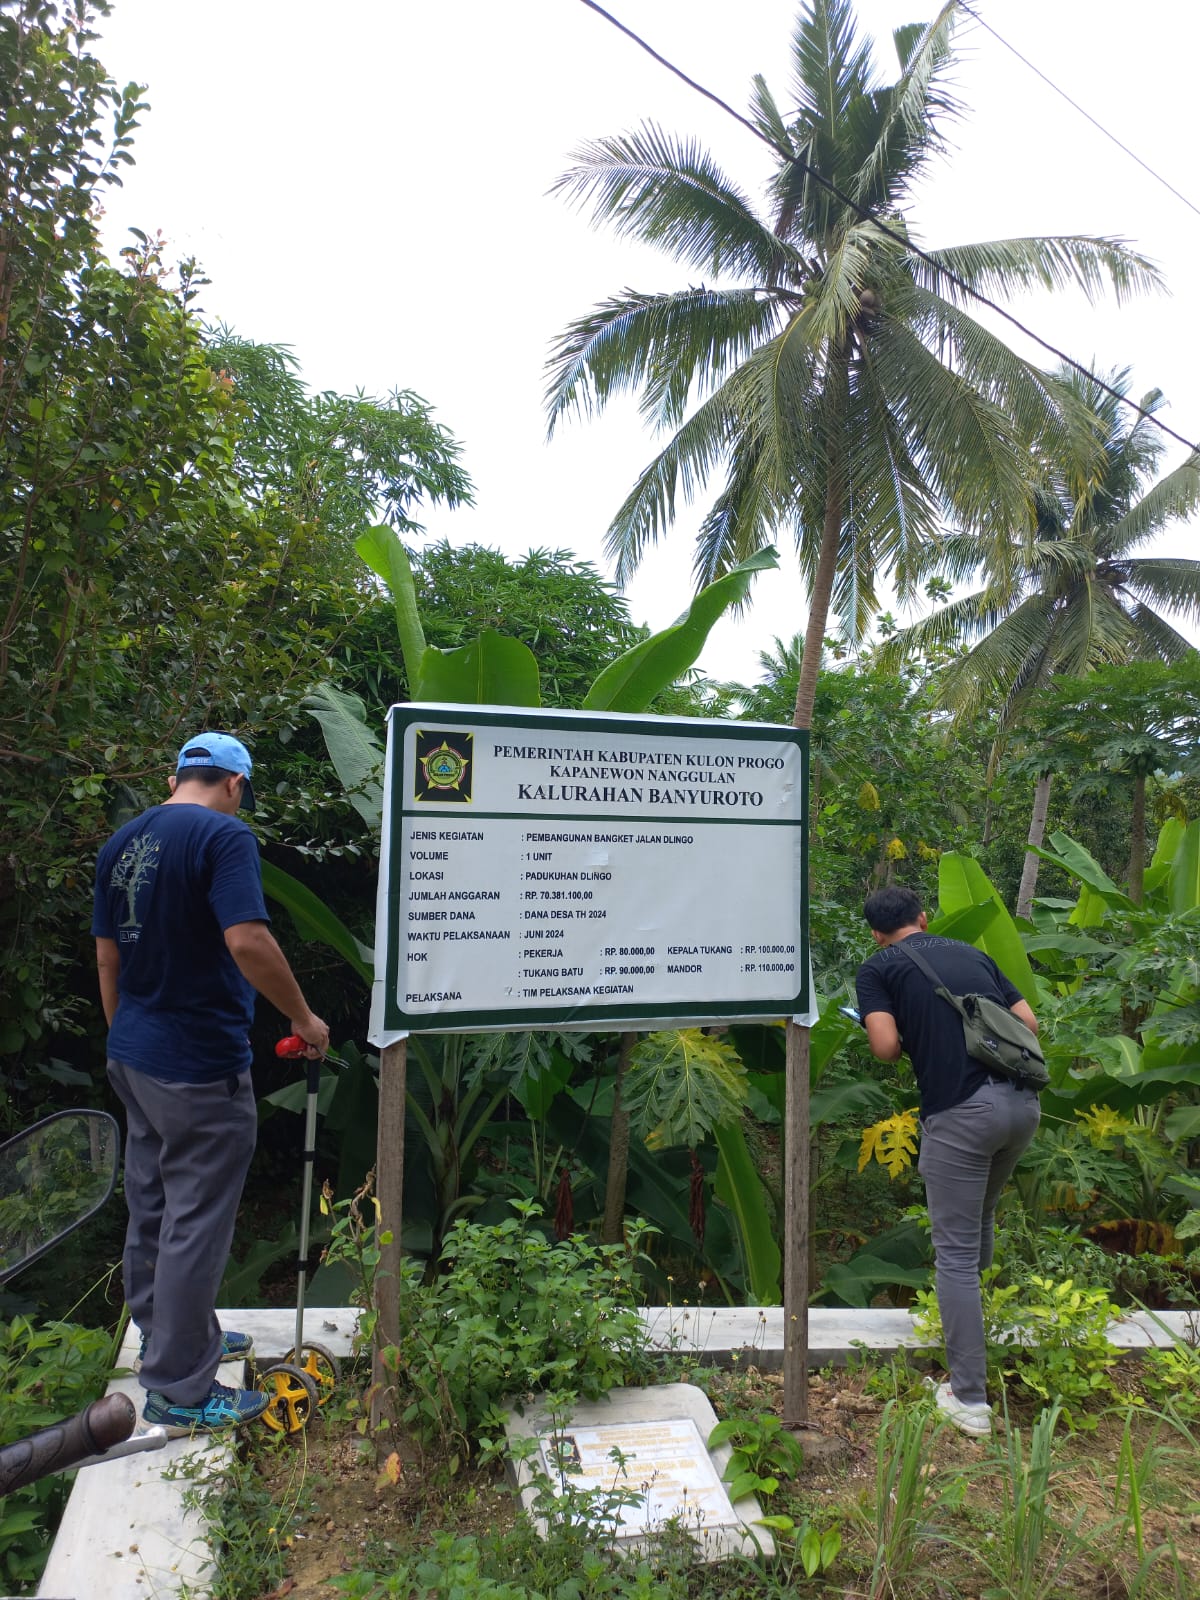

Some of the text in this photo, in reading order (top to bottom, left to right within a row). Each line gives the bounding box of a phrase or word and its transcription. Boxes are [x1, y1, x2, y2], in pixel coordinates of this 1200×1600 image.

[494, 745, 785, 769] PEMERINTAH KABUPATEN KULON PROGO
[550, 766, 736, 784] KAPANEWON NANGGULAN
[518, 784, 764, 807] KALURAHAN BANYUROTO
[410, 831, 437, 840] JENIS
[439, 832, 484, 841] KEGIATAN
[526, 833, 592, 843] PEMBANGUNAN
[594, 834, 633, 843] BANGKET
[635, 835, 661, 844] JALAN
[663, 835, 694, 844] DLINGO
[410, 851, 449, 861] VOLUME
[526, 852, 531, 861] 1
[533, 852, 553, 861] UNIT
[409, 871, 444, 881] LOKASI
[525, 871, 578, 881] PADUKUHAN
[580, 872, 612, 881] DLINGO
[408, 891, 447, 901] JUMLAH
[448, 891, 500, 900] ANGGARAN
[540, 891, 593, 900] 70.381.100,00
[408, 911, 447, 921] SUMBER
[450, 911, 476, 920] DANA
[524, 911, 548, 920] DANA
[550, 910, 574, 919] DESA
[575, 910, 587, 919] TH
[588, 910, 607, 919] 2024
[407, 932, 441, 941] WAKTU
[443, 930, 511, 940] PELAKSANAAN
[523, 930, 544, 939] JUNI
[545, 930, 565, 939] 2024
[407, 952, 428, 962] HOK
[523, 949, 564, 958] PEKERJA
[619, 946, 655, 956] 80.000,00
[667, 946, 699, 955] KEPALA
[700, 945, 733, 955] TUKANG
[758, 945, 795, 954] 100.000,00
[523, 968, 559, 978] TUKANG
[561, 967, 584, 977] BATU
[619, 966, 655, 975] 90.000,00
[667, 965, 703, 973] MANDOR
[758, 963, 795, 972] 110.000,00
[405, 992, 462, 1003] PELAKSANA
[522, 989, 538, 998] TIM
[539, 986, 591, 998] PELAKSANA
[593, 985, 634, 994] KEGIATAN
